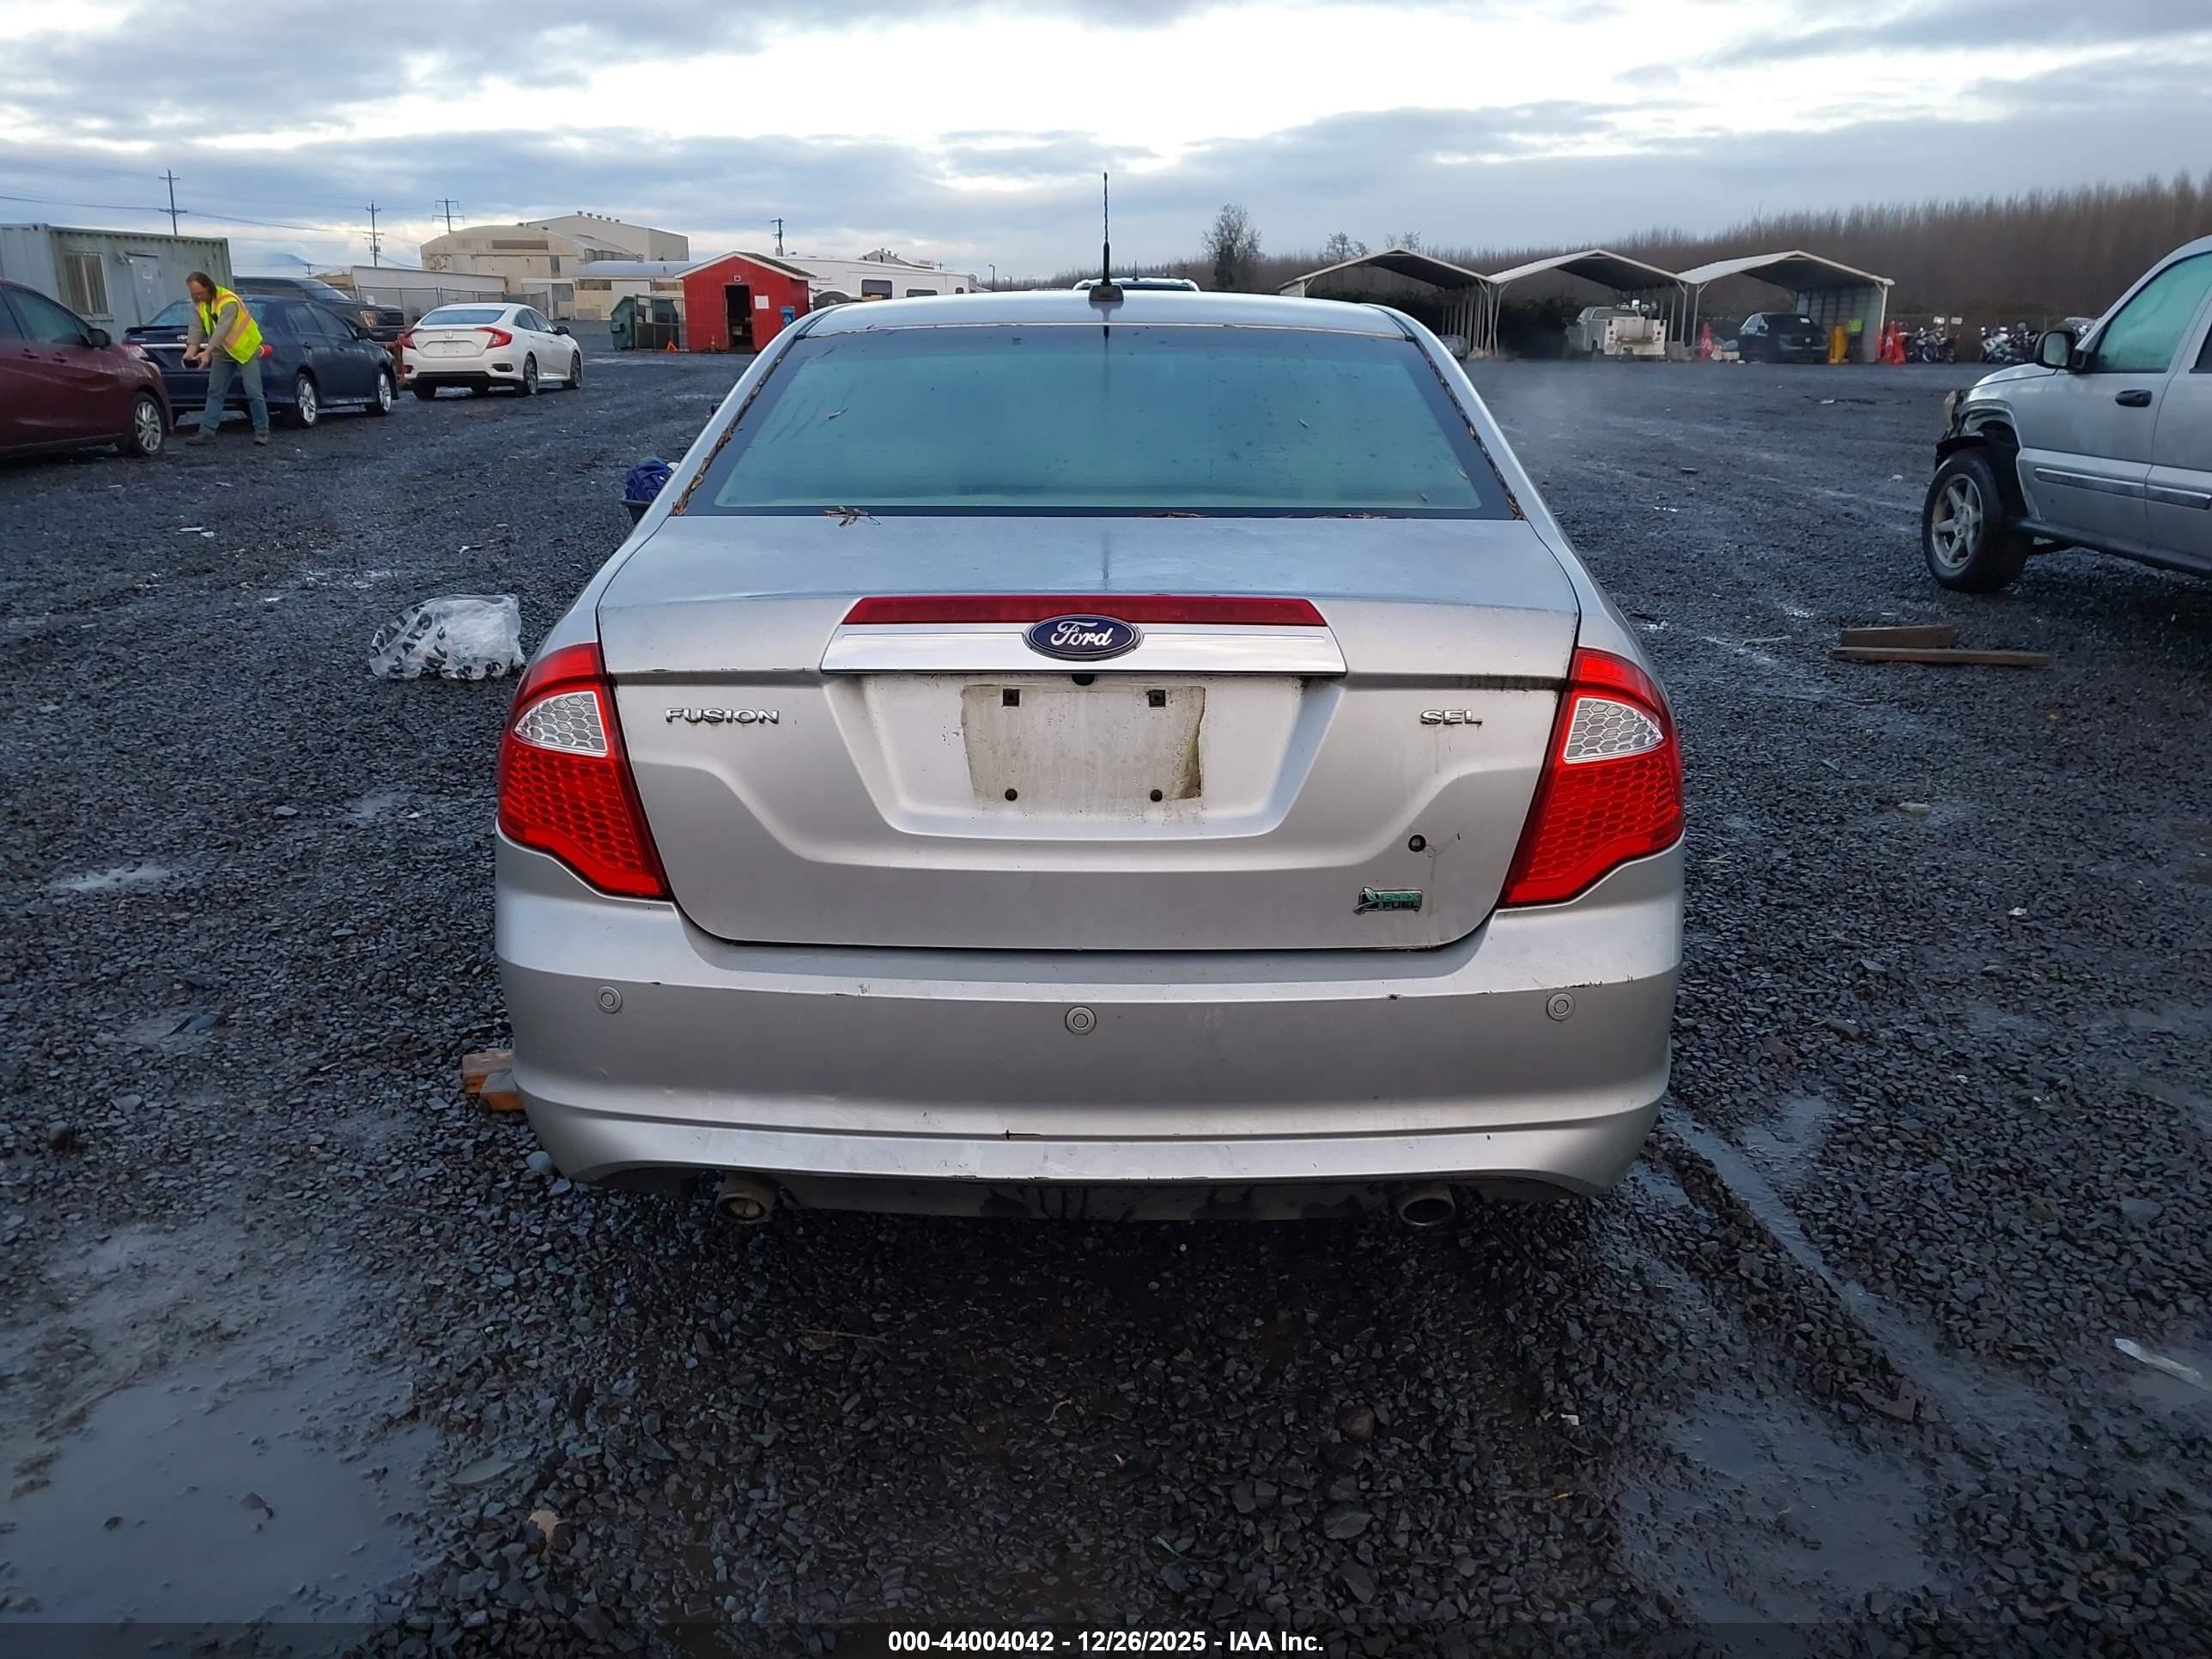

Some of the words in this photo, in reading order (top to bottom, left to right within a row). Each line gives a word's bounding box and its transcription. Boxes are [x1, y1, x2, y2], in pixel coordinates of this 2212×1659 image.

[1050, 620, 1114, 646] Ford
[665, 708, 779, 725] FUSION
[1420, 709, 1483, 726] SEL
[1382, 901, 1418, 909] FUEL
